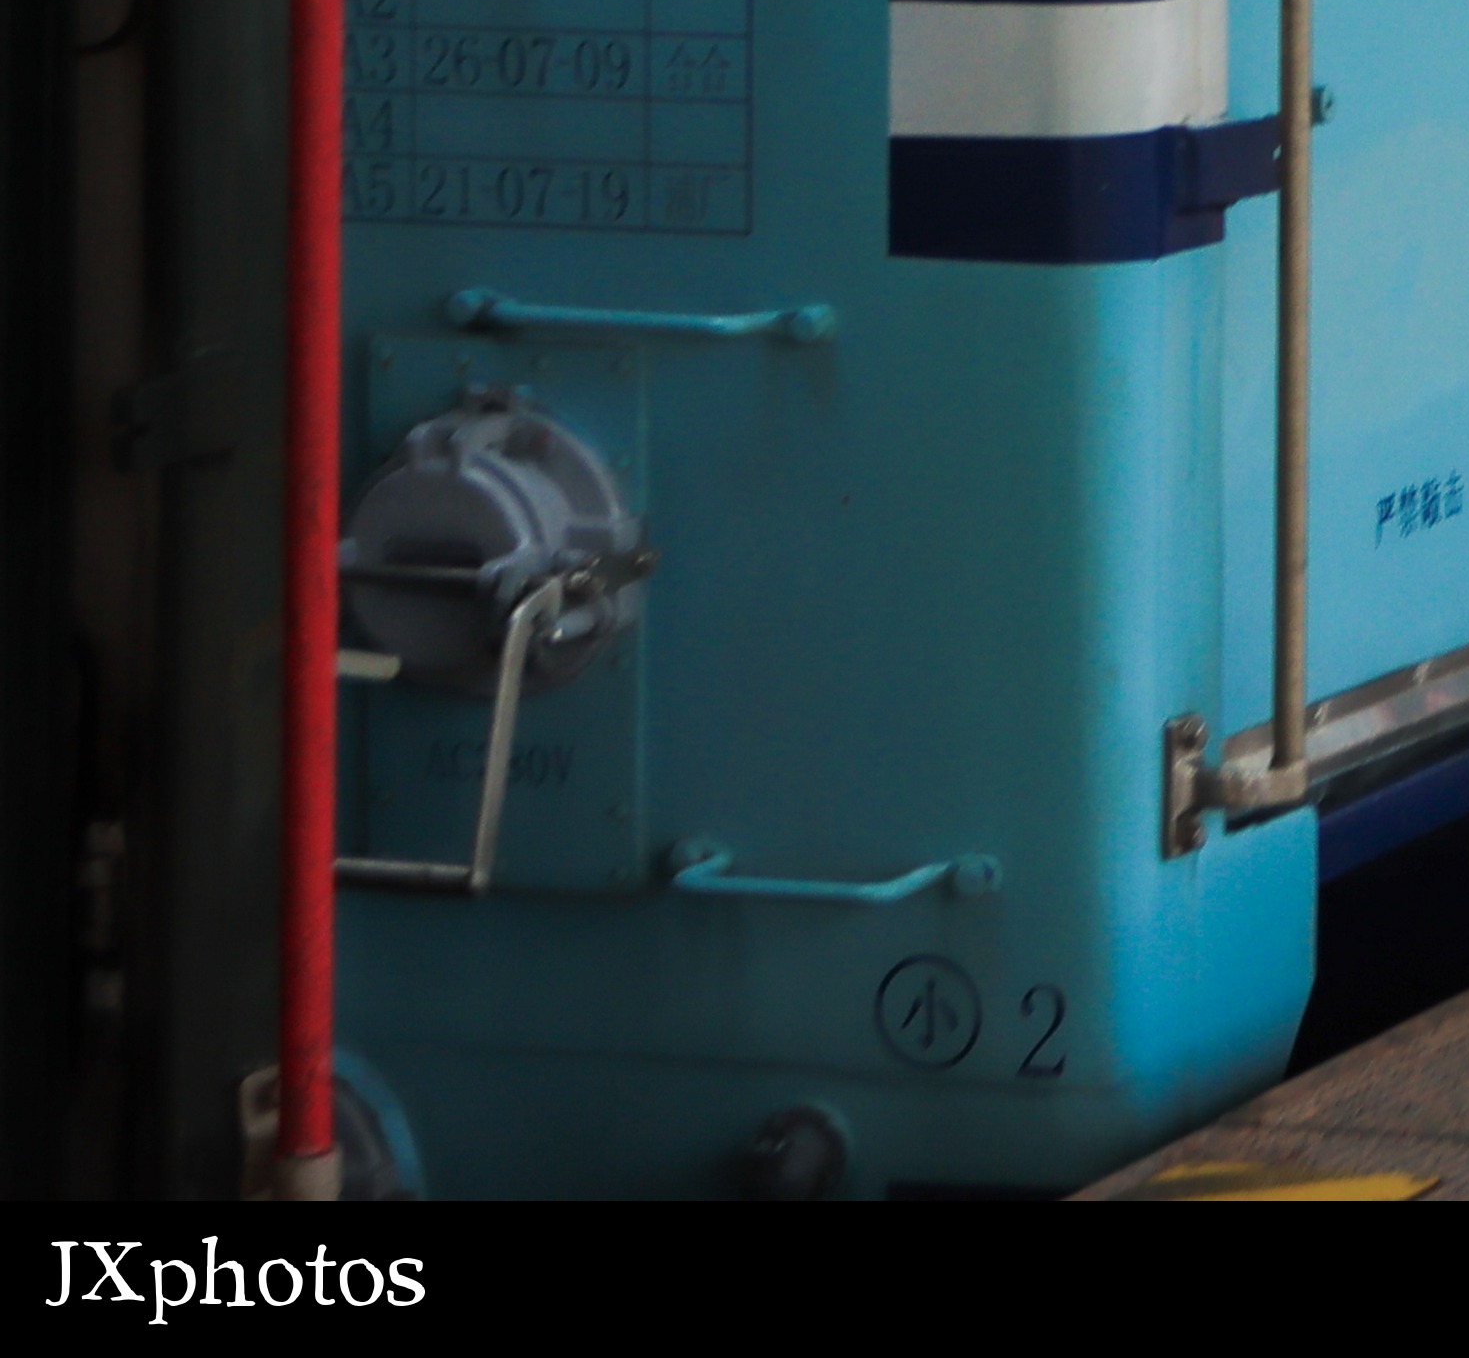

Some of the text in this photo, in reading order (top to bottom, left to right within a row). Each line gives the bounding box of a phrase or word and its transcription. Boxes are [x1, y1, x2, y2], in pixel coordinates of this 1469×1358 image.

[422, 36, 632, 92] 26-07-09
[420, 163, 630, 222] 21-07-19
[1016, 982, 1067, 1078] 2
